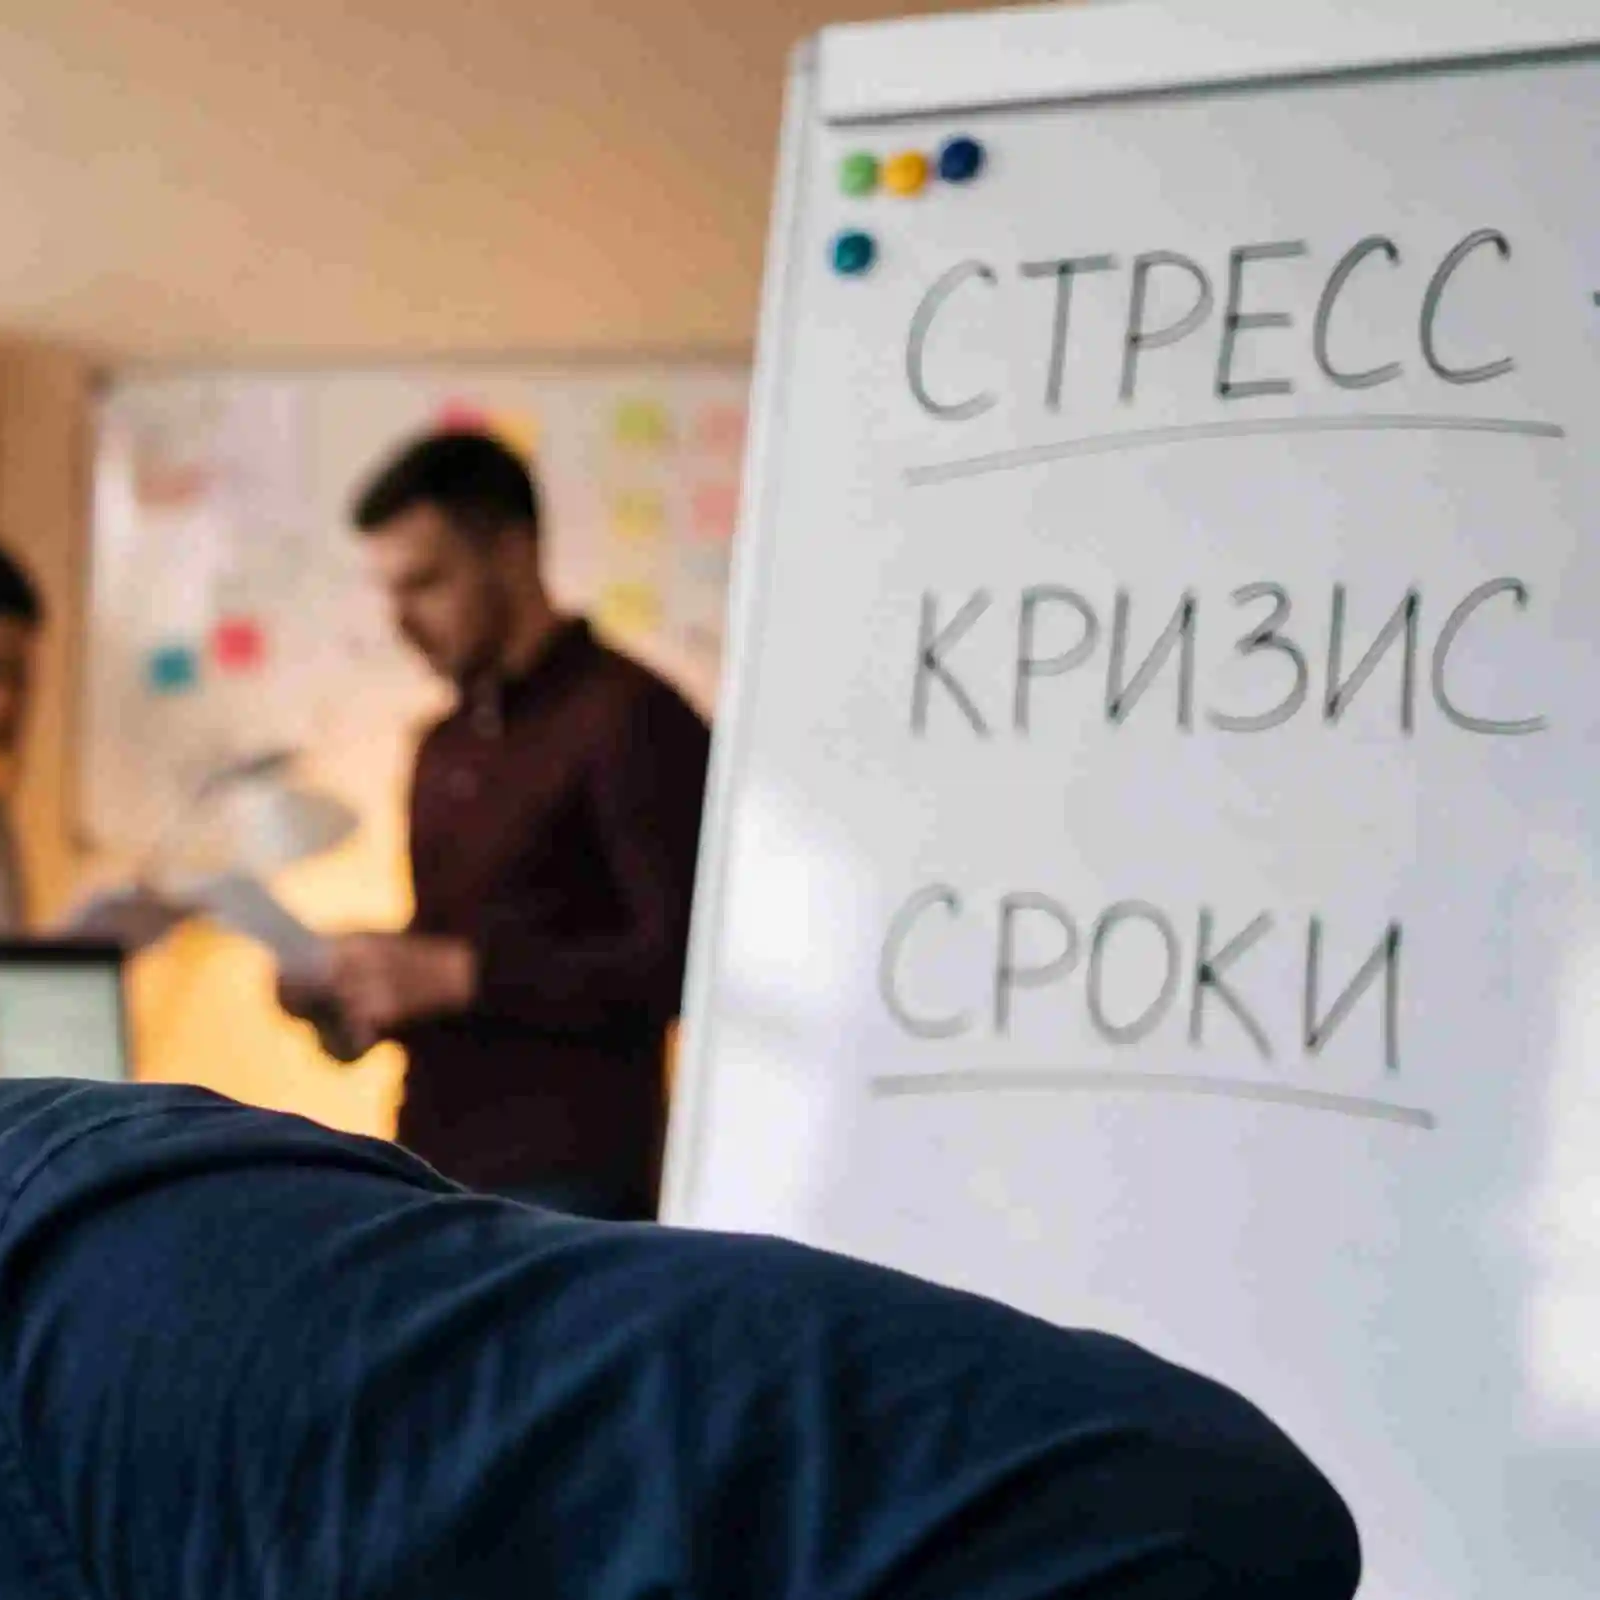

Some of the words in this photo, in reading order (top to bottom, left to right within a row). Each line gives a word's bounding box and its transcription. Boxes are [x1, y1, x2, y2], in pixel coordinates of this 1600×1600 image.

[906, 229, 1515, 420] СТРЕСС
[911, 578, 1547, 735] КРИЗИС
[882, 885, 1402, 1070] СРОКИ
